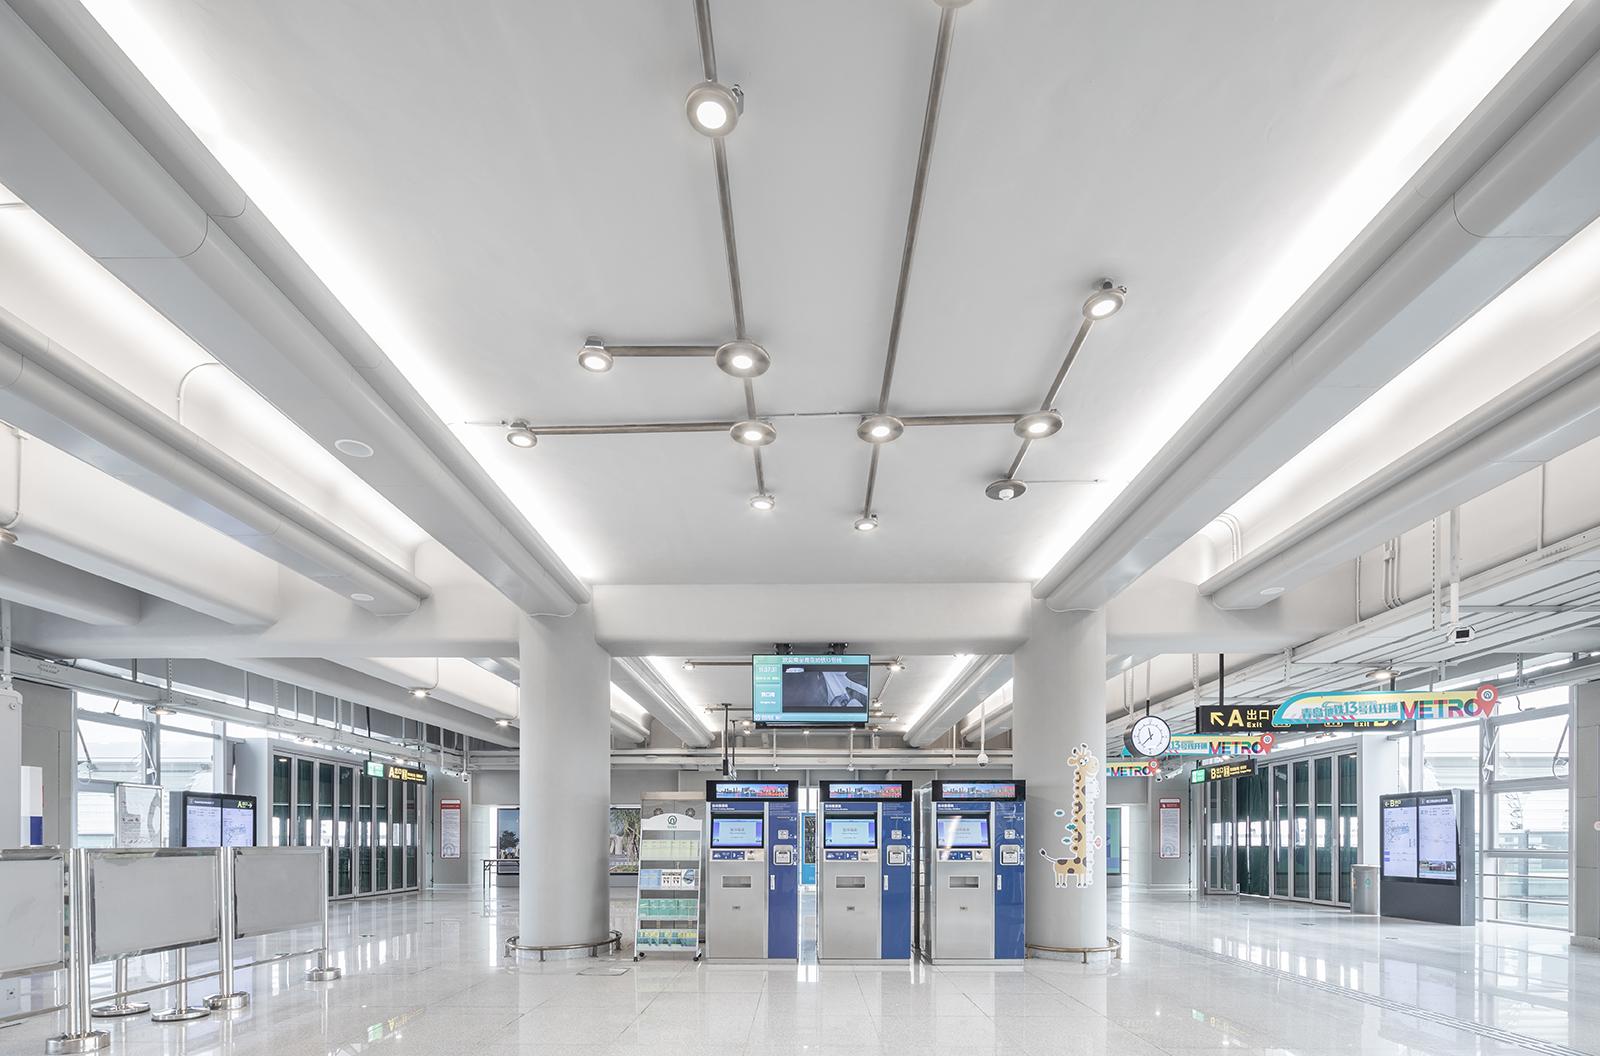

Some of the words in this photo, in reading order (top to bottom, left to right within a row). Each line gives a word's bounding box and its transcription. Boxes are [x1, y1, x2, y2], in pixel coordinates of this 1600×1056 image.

[1246, 709, 1269, 720] 出口
[1400, 698, 1483, 720] METRO
[1227, 709, 1244, 727] A
[1209, 741, 1264, 756] METRO
[388, 766, 395, 778] A
[1110, 766, 1151, 777] METRO
[1210, 768, 1216, 780] B
